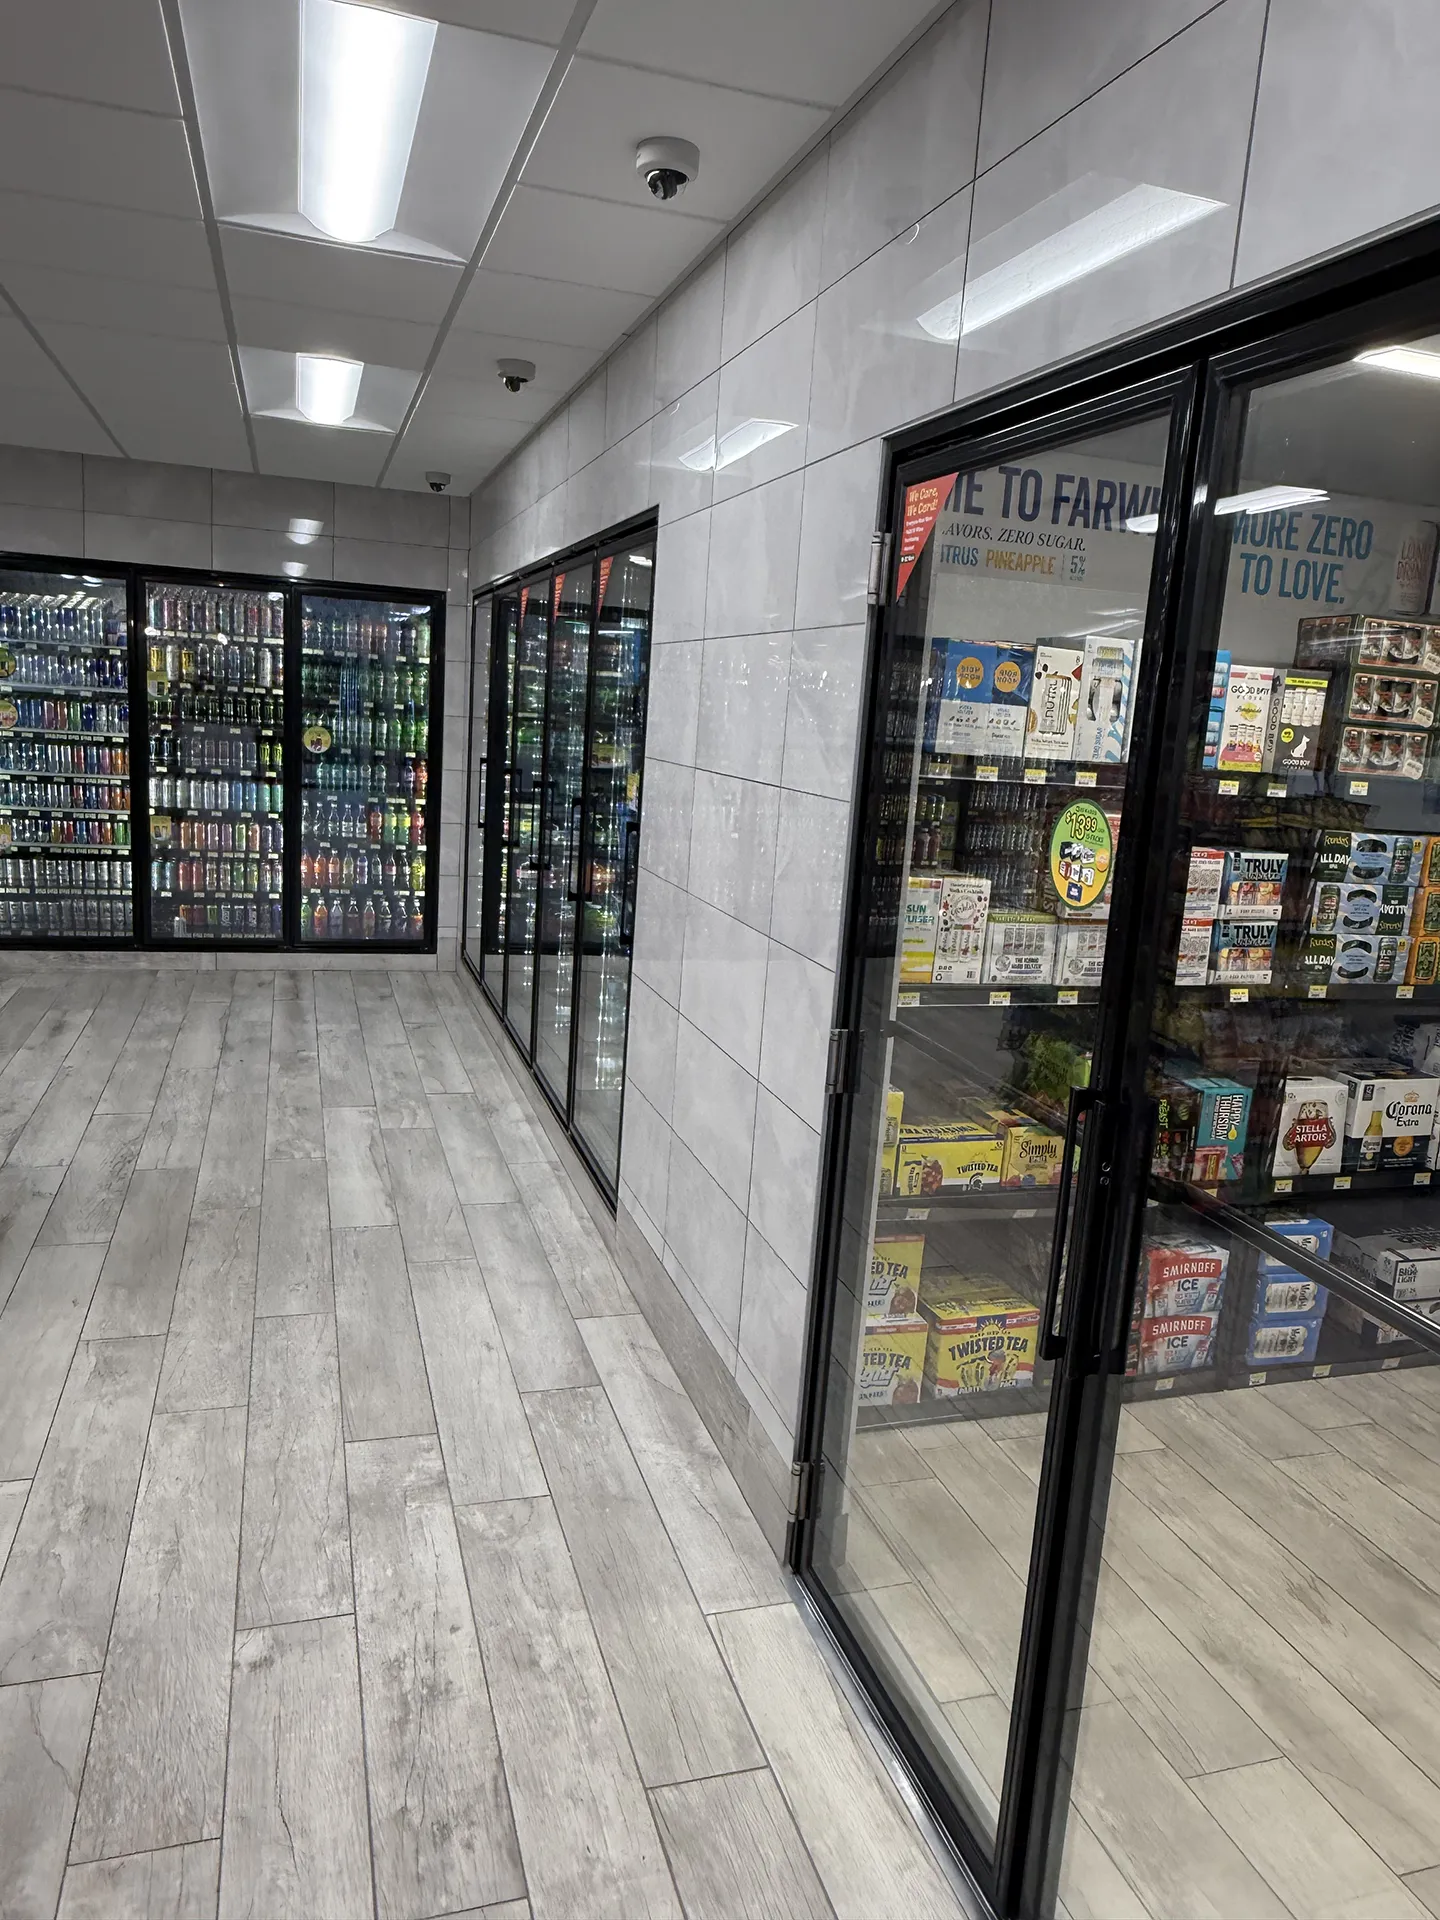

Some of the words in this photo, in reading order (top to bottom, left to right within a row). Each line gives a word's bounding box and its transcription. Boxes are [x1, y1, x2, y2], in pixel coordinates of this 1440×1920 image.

[909, 491, 919, 503] We
[998, 465, 1043, 523] TO
[907, 504, 917, 517] We
[997, 527, 1034, 546] ZERO
[1036, 533, 1086, 551] SUGAR.
[1306, 513, 1374, 560] ZERO
[985, 549, 1056, 576] PINEAPPLE
[1240, 552, 1273, 596] TO
[1278, 557, 1345, 604] LOVE.
[1244, 858, 1285, 874] TRULY
[1334, 853, 1351, 865] DAY
[906, 903, 927, 914] SUN
[1233, 925, 1275, 939] TRULY
[1318, 955, 1335, 966] DAY
[1215, 1094, 1233, 1141] THURSDAY
[1230, 1094, 1244, 1126] HAPPY
[1386, 1101, 1432, 1120] Corona
[1295, 1122, 1328, 1134] STELLA
[1396, 1115, 1419, 1127] Extra
[1294, 1132, 1328, 1143] ARTOIS
[1019, 1140, 1058, 1160] Simply
[956, 1162, 986, 1174] TWISTED
[986, 1162, 999, 1173] TEA
[886, 1262, 909, 1279] TEA
[1162, 1261, 1216, 1278] SMIRNOFF
[1177, 1278, 1199, 1292] ICE
[1152, 1319, 1206, 1336] SMIRNOFF
[948, 1337, 1005, 1361] TWISTED
[1006, 1336, 1029, 1353] TEA
[1166, 1336, 1189, 1349] ICE
[888, 1355, 912, 1370] TEA
